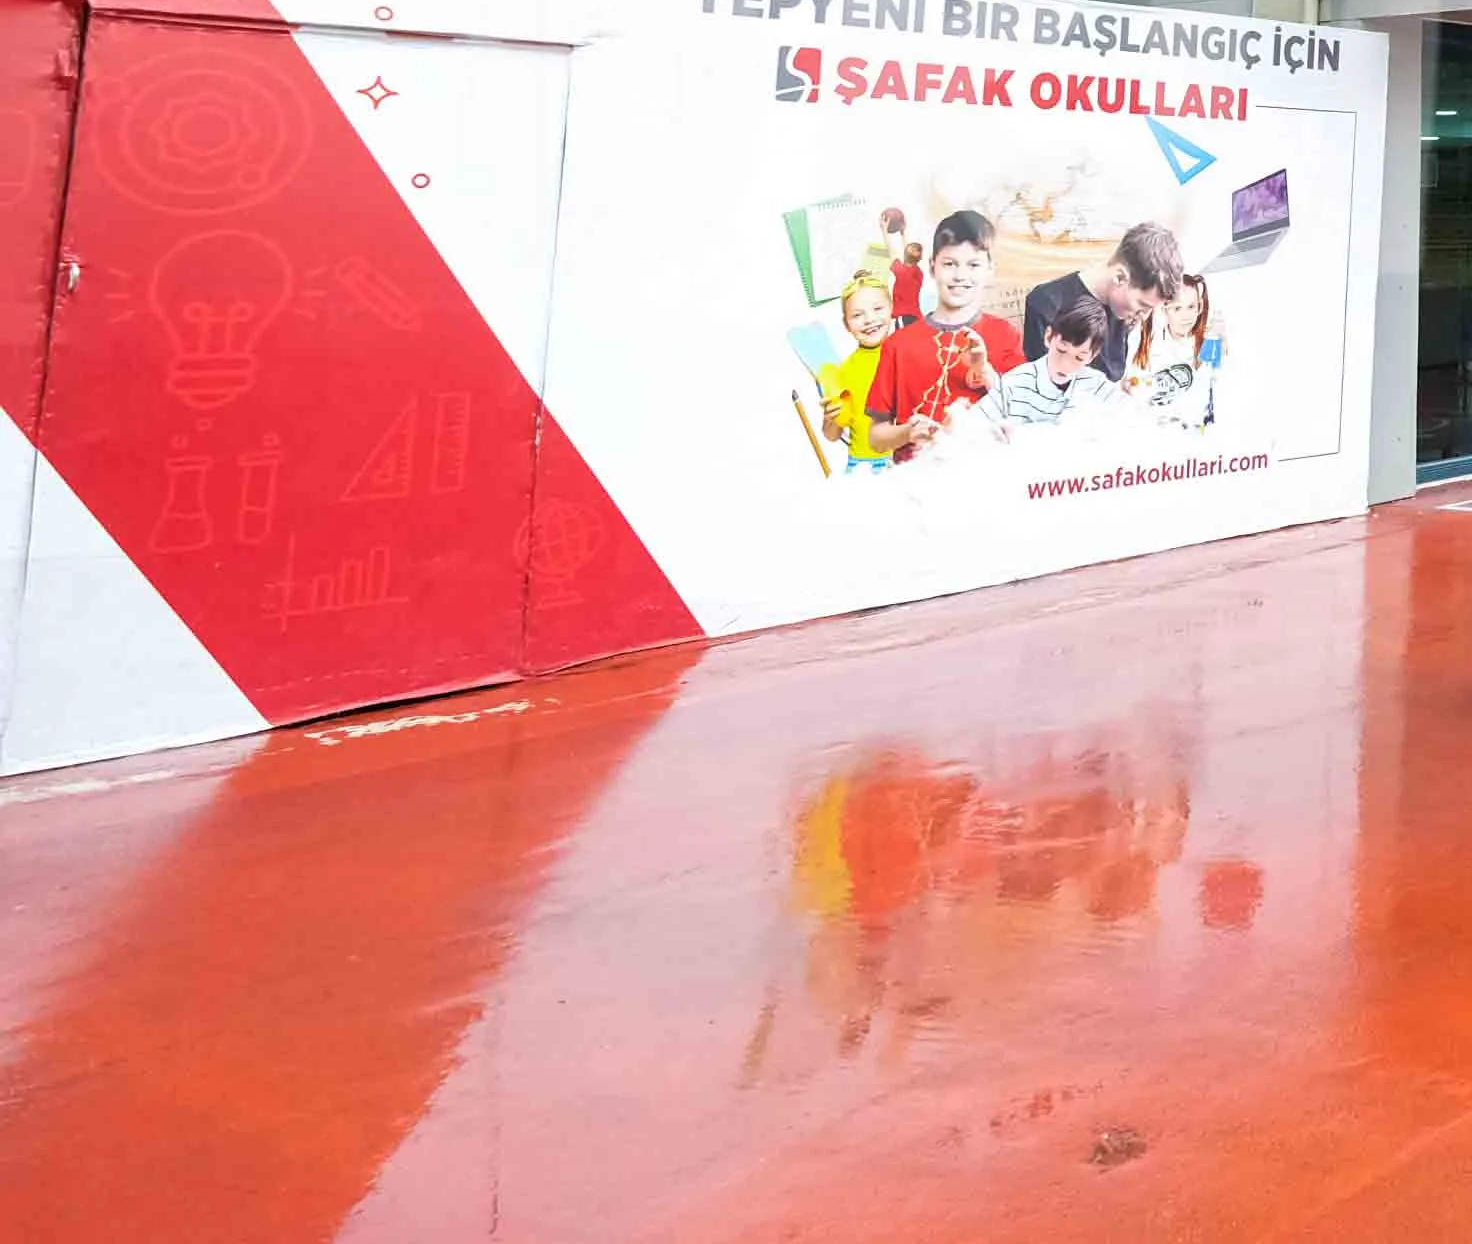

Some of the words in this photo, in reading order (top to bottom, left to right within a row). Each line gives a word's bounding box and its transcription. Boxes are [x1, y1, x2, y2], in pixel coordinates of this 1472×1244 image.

[1033, 8, 1262, 70] BAŞLANGIÇ
[1273, 26, 1341, 74] İÇİN
[834, 57, 1016, 107] ŞAFAK
[1030, 72, 1249, 121] OKULLARI
[1027, 453, 1268, 500] www.safakokullari.com
